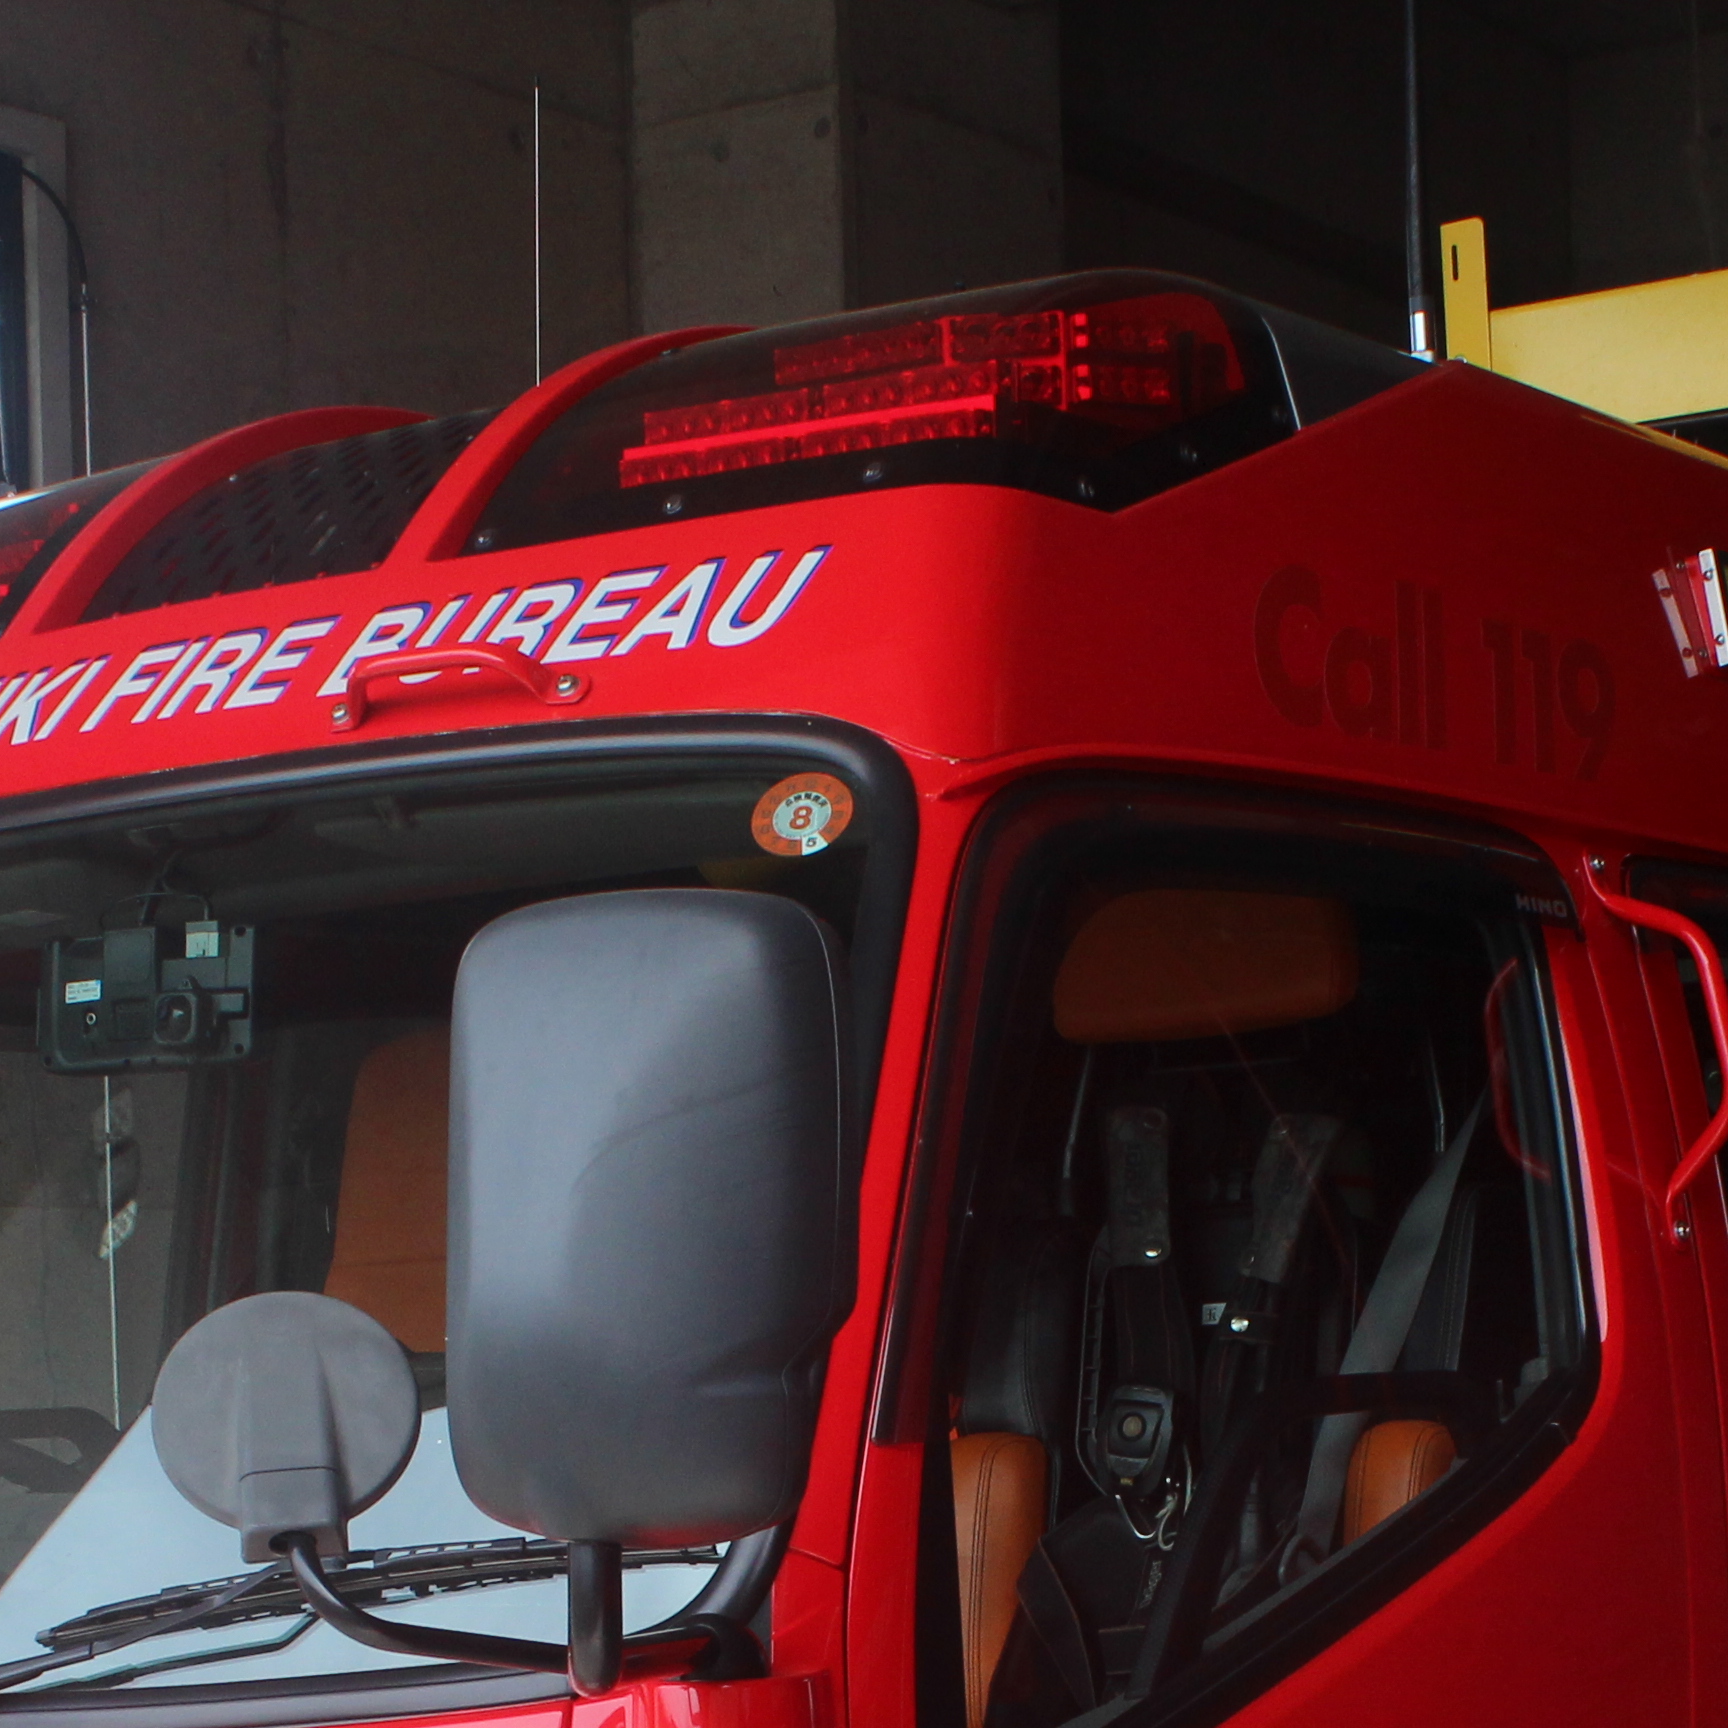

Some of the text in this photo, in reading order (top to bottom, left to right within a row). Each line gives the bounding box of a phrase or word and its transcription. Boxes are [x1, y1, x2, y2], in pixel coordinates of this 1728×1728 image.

[79, 615, 343, 733] FIRE
[316, 545, 834, 697] BUREAU
[1253, 565, 1617, 782] Call 119
[789, 806, 813, 830] 8
[1514, 893, 1568, 918] HINO
